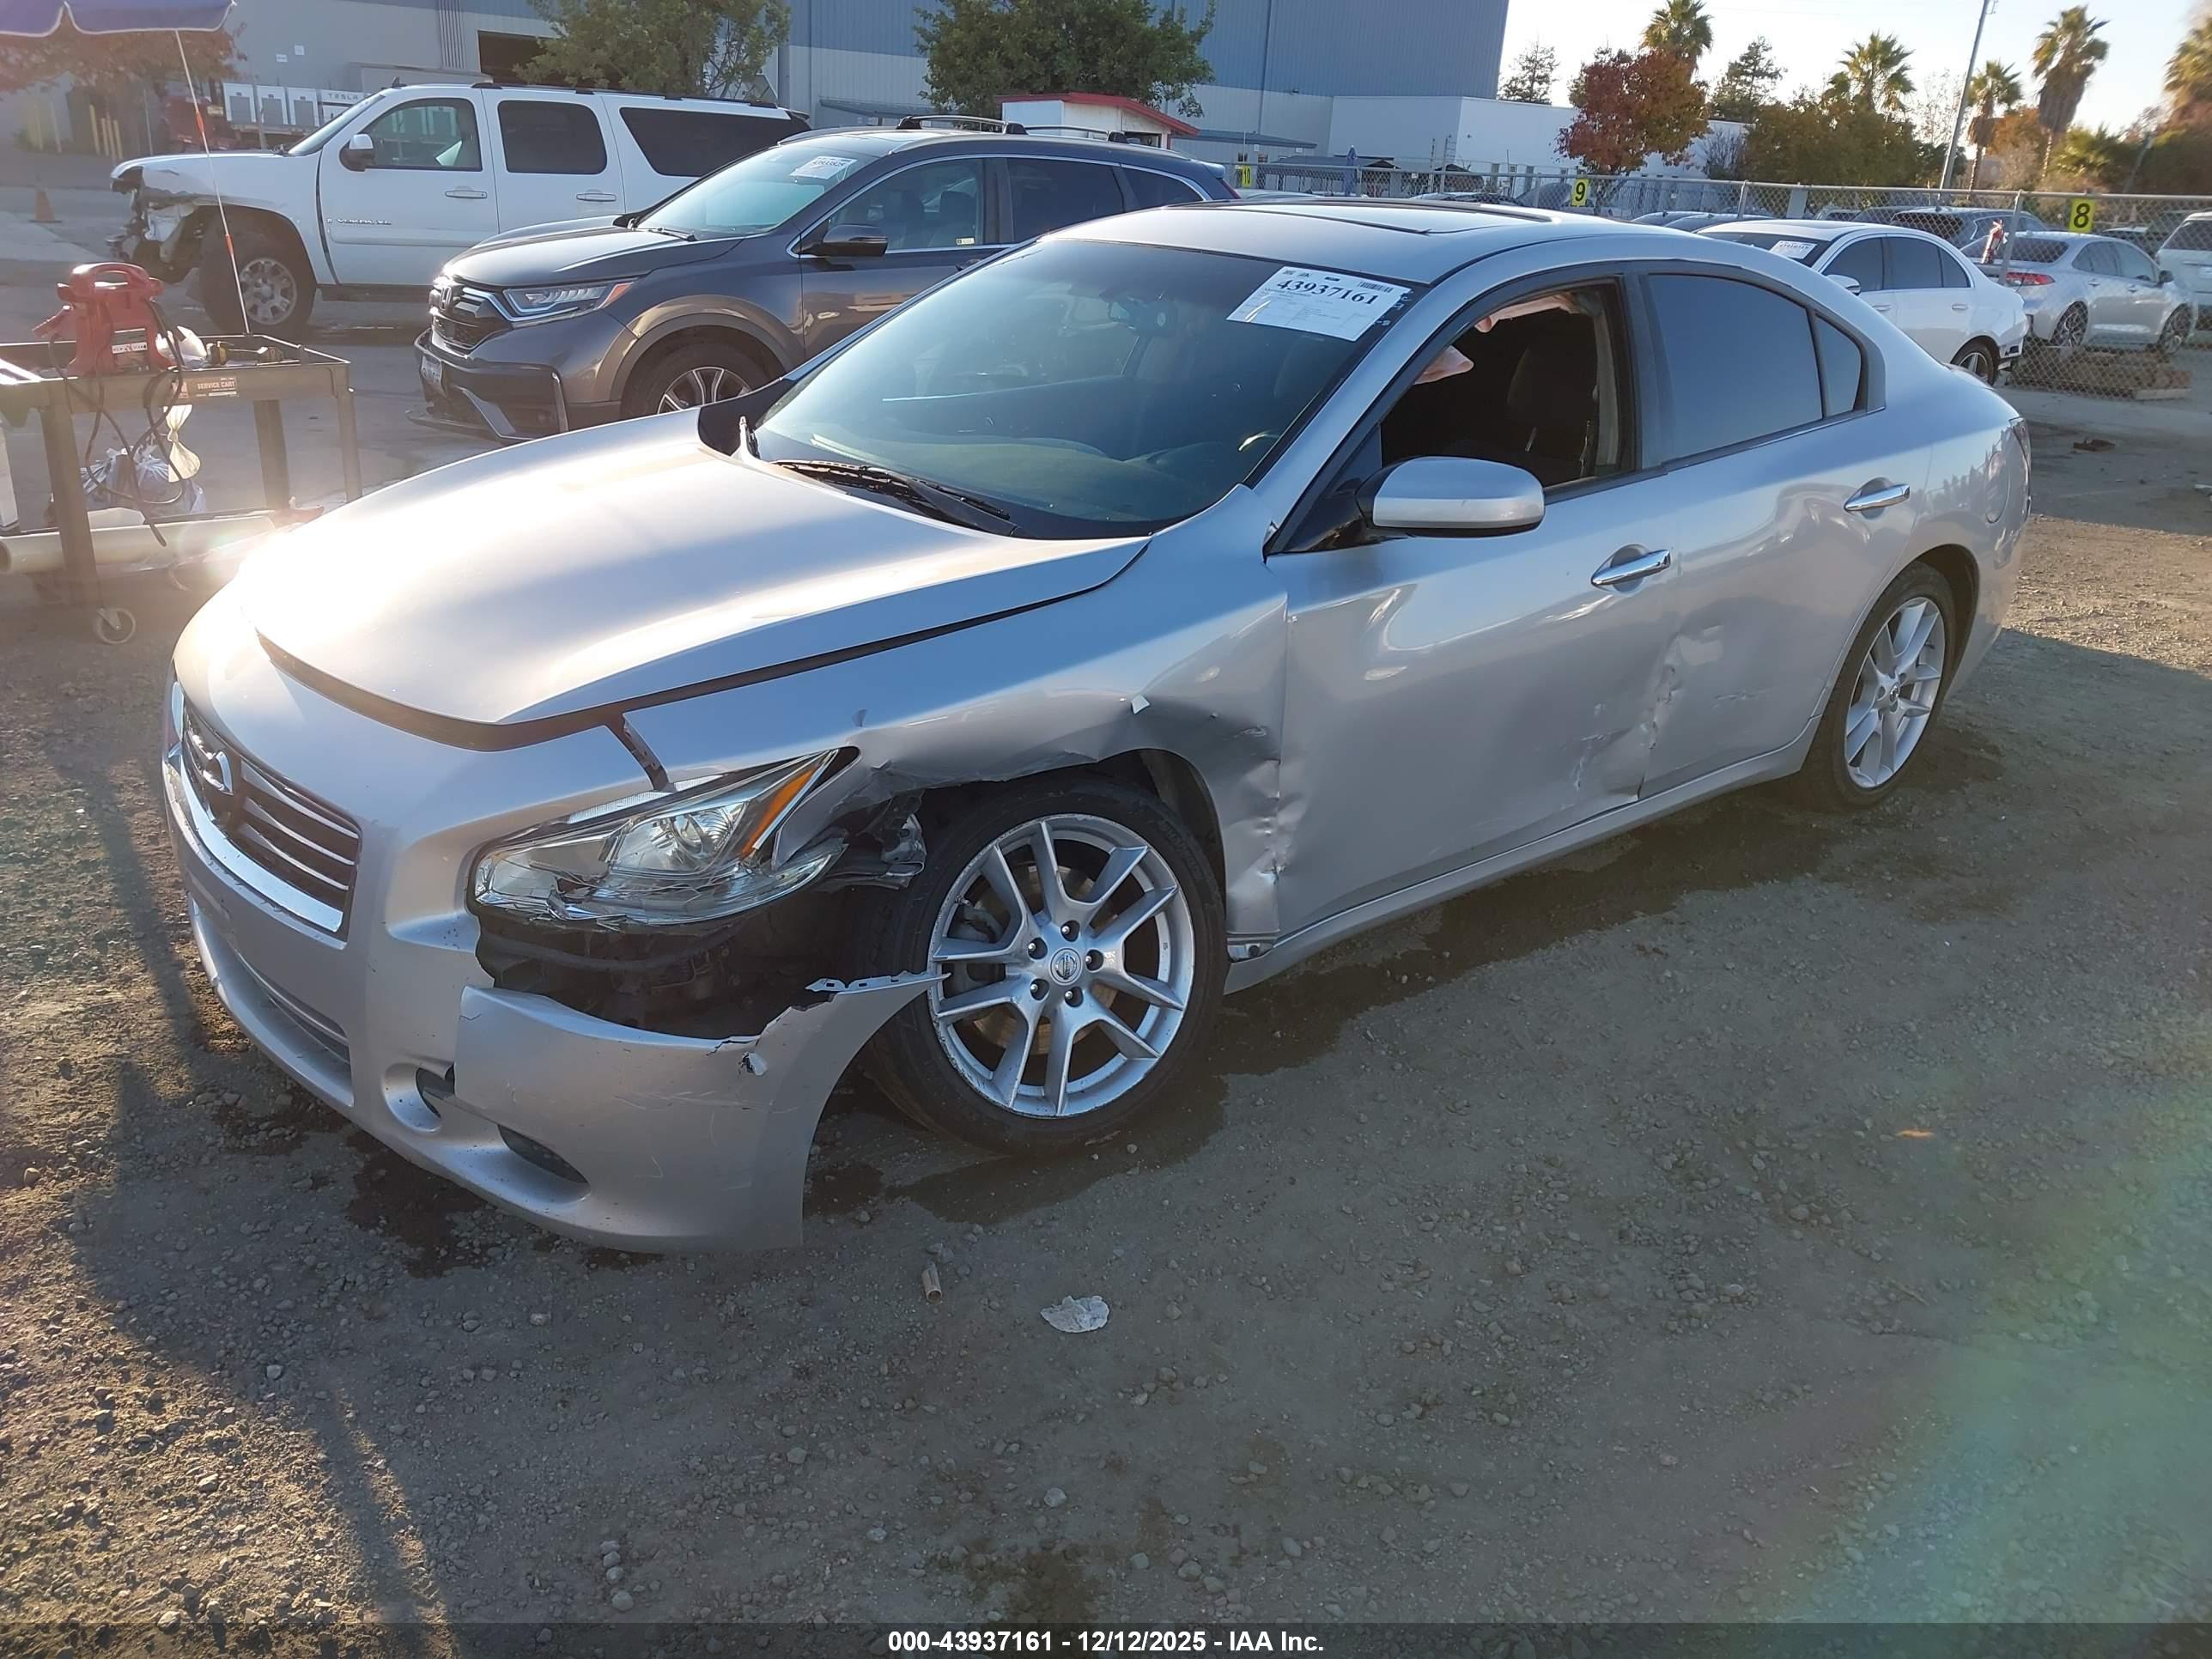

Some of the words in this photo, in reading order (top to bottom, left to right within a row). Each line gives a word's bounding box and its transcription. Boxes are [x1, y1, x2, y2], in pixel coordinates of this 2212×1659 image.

[1243, 167, 1251, 185] 10
[1575, 182, 1586, 202] 9
[2074, 203, 2090, 228] 8
[1278, 279, 1378, 305] 43937161
